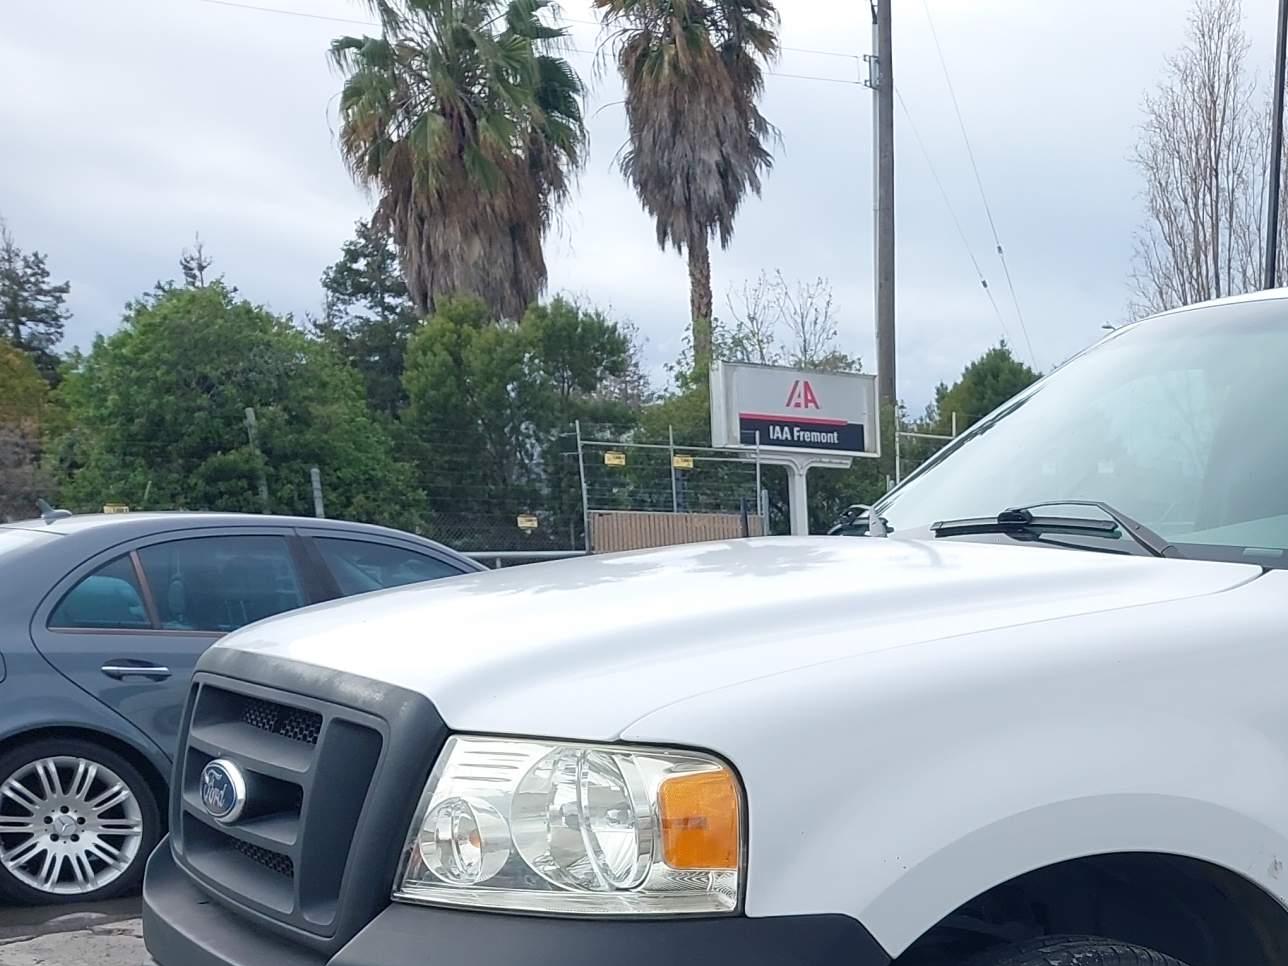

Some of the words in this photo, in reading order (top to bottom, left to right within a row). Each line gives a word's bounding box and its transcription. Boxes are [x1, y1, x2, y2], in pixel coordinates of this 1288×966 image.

[769, 425, 791, 440] IAA
[793, 427, 839, 443] Fremont
[203, 769, 228, 808] Ford
